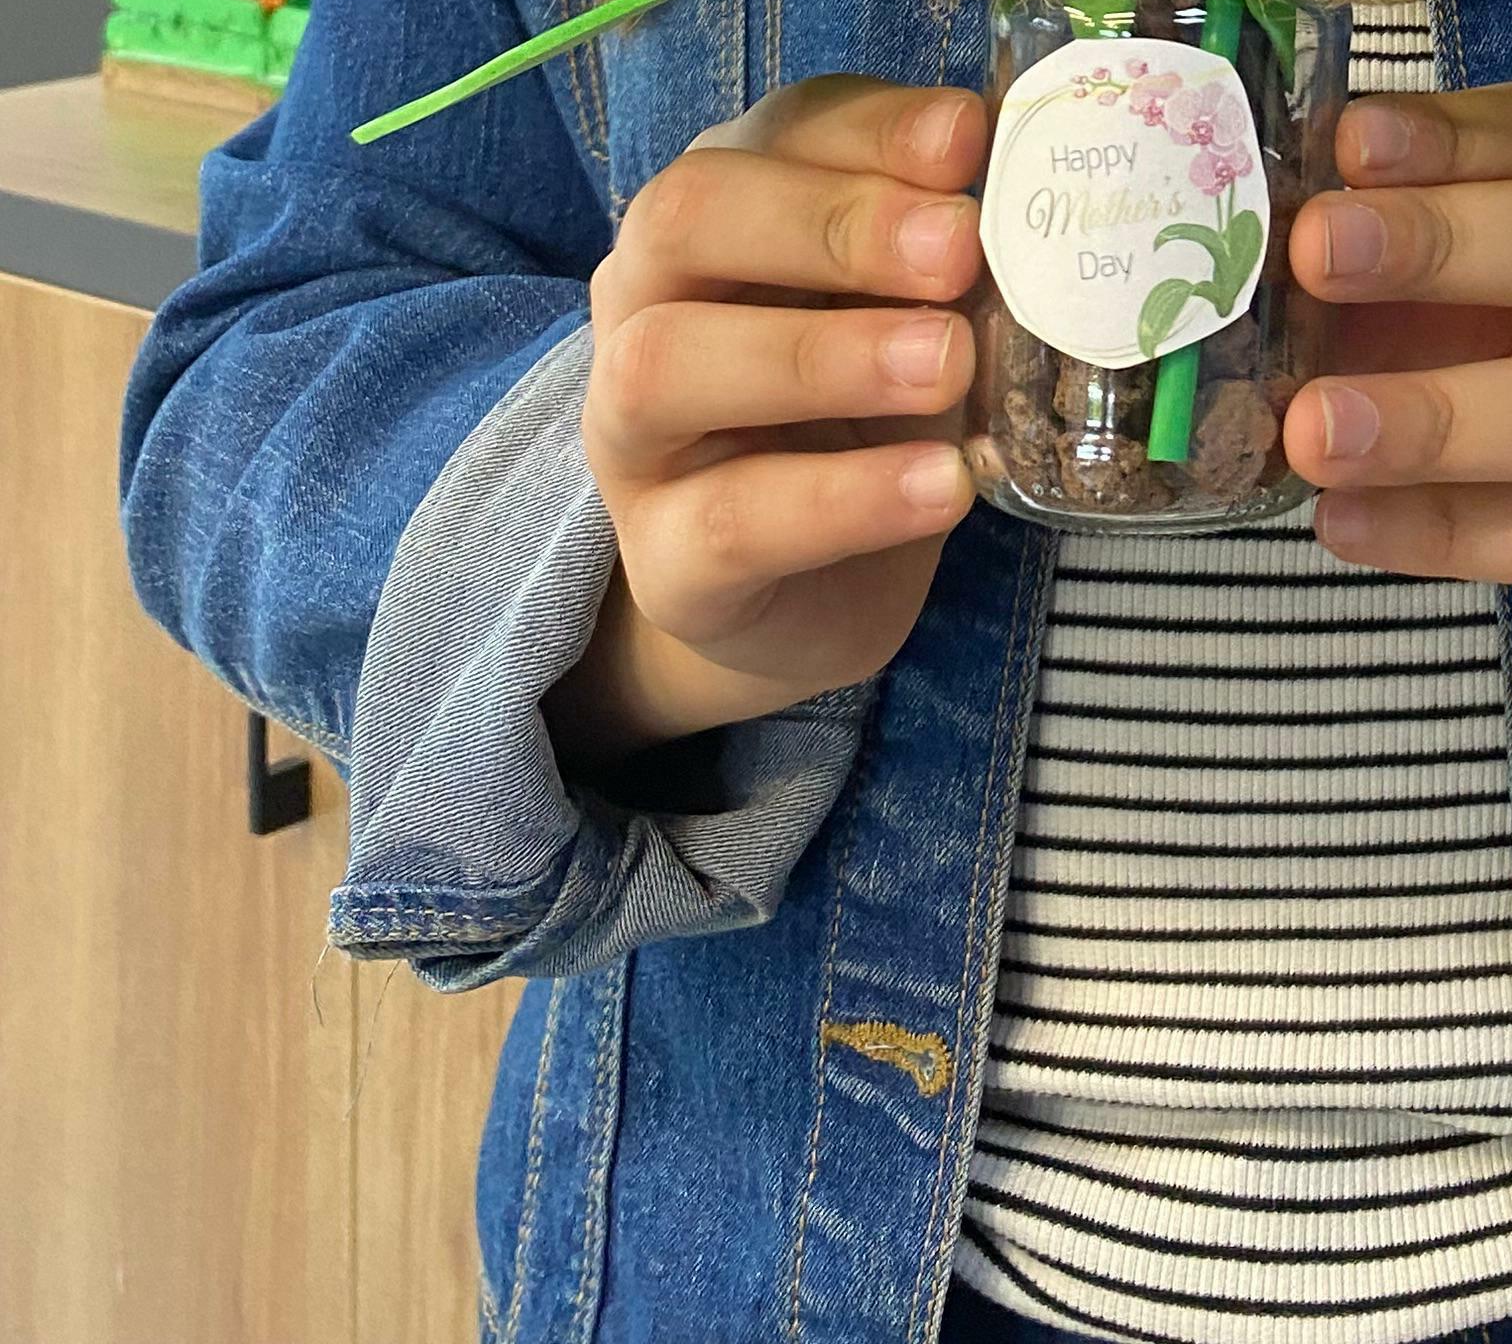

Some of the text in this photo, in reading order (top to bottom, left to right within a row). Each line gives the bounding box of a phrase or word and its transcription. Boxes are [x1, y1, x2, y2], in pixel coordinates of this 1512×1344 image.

[1050, 142, 1138, 176] Happy
[1025, 175, 1184, 239] Mother's
[1078, 250, 1133, 282] Day
